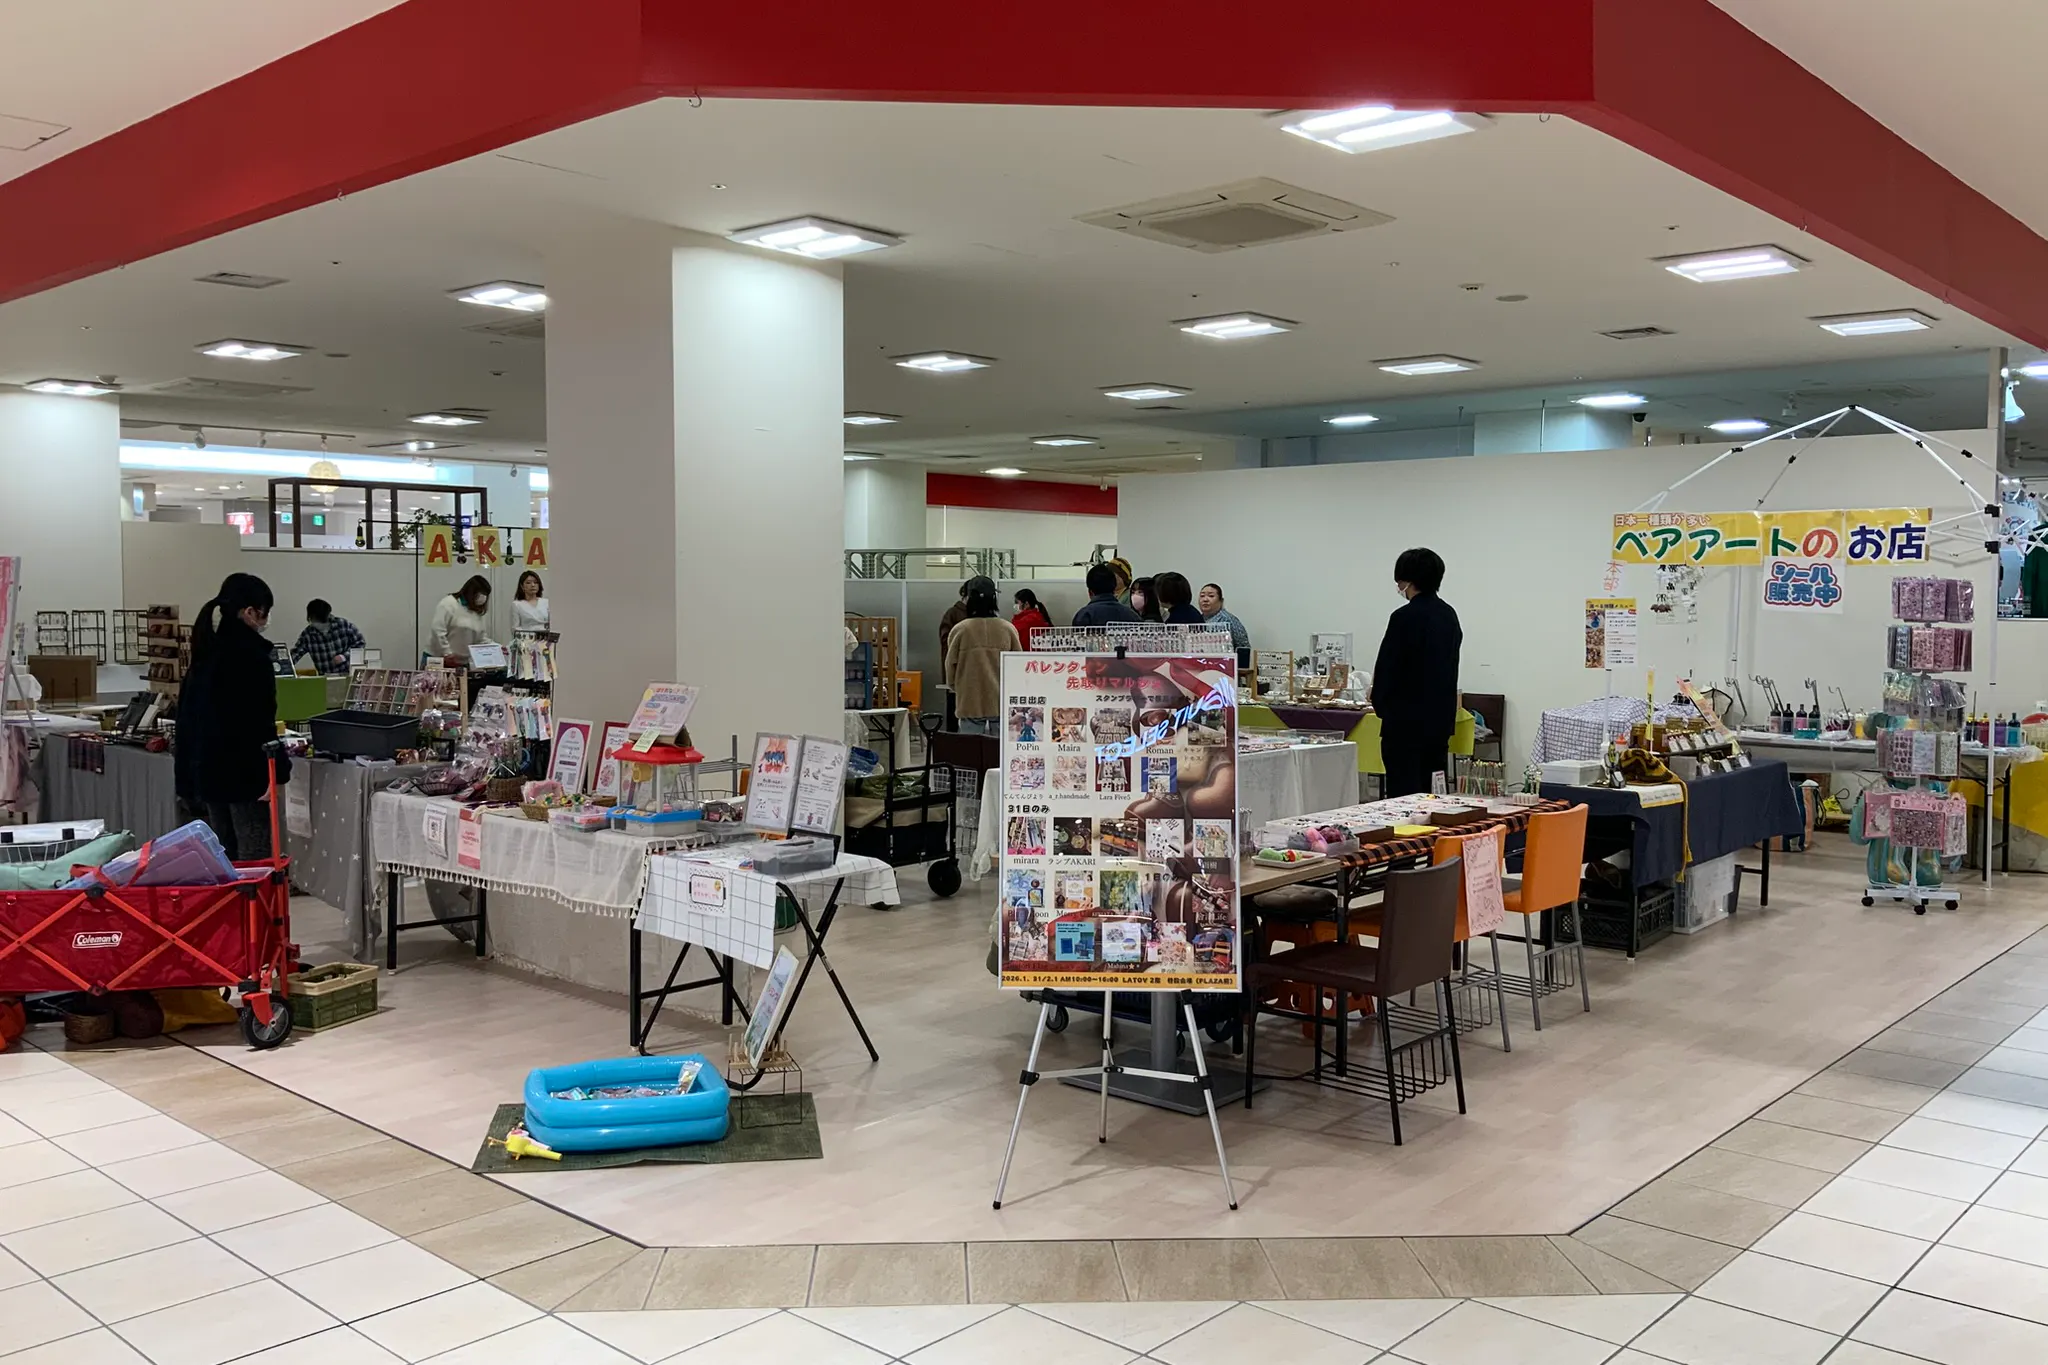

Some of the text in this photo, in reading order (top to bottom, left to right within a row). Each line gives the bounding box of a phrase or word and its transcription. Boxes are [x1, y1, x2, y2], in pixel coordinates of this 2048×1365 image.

[1775, 564, 1834, 584] シール
[1768, 583, 1838, 603] 販売中
[1025, 660, 1108, 674] バレンタイン
[1066, 676, 1161, 691] 先取りマルシェ
[1009, 696, 1047, 705] 両日出店
[1016, 743, 1040, 751] PoPin
[1058, 743, 1081, 752] Maira
[1146, 746, 1174, 754] Roman
[1008, 804, 1050, 813] 31日のみ
[1013, 856, 1040, 864] mirara
[1048, 858, 1096, 866] ランプAKARI
[77, 934, 111, 945] Coleman
